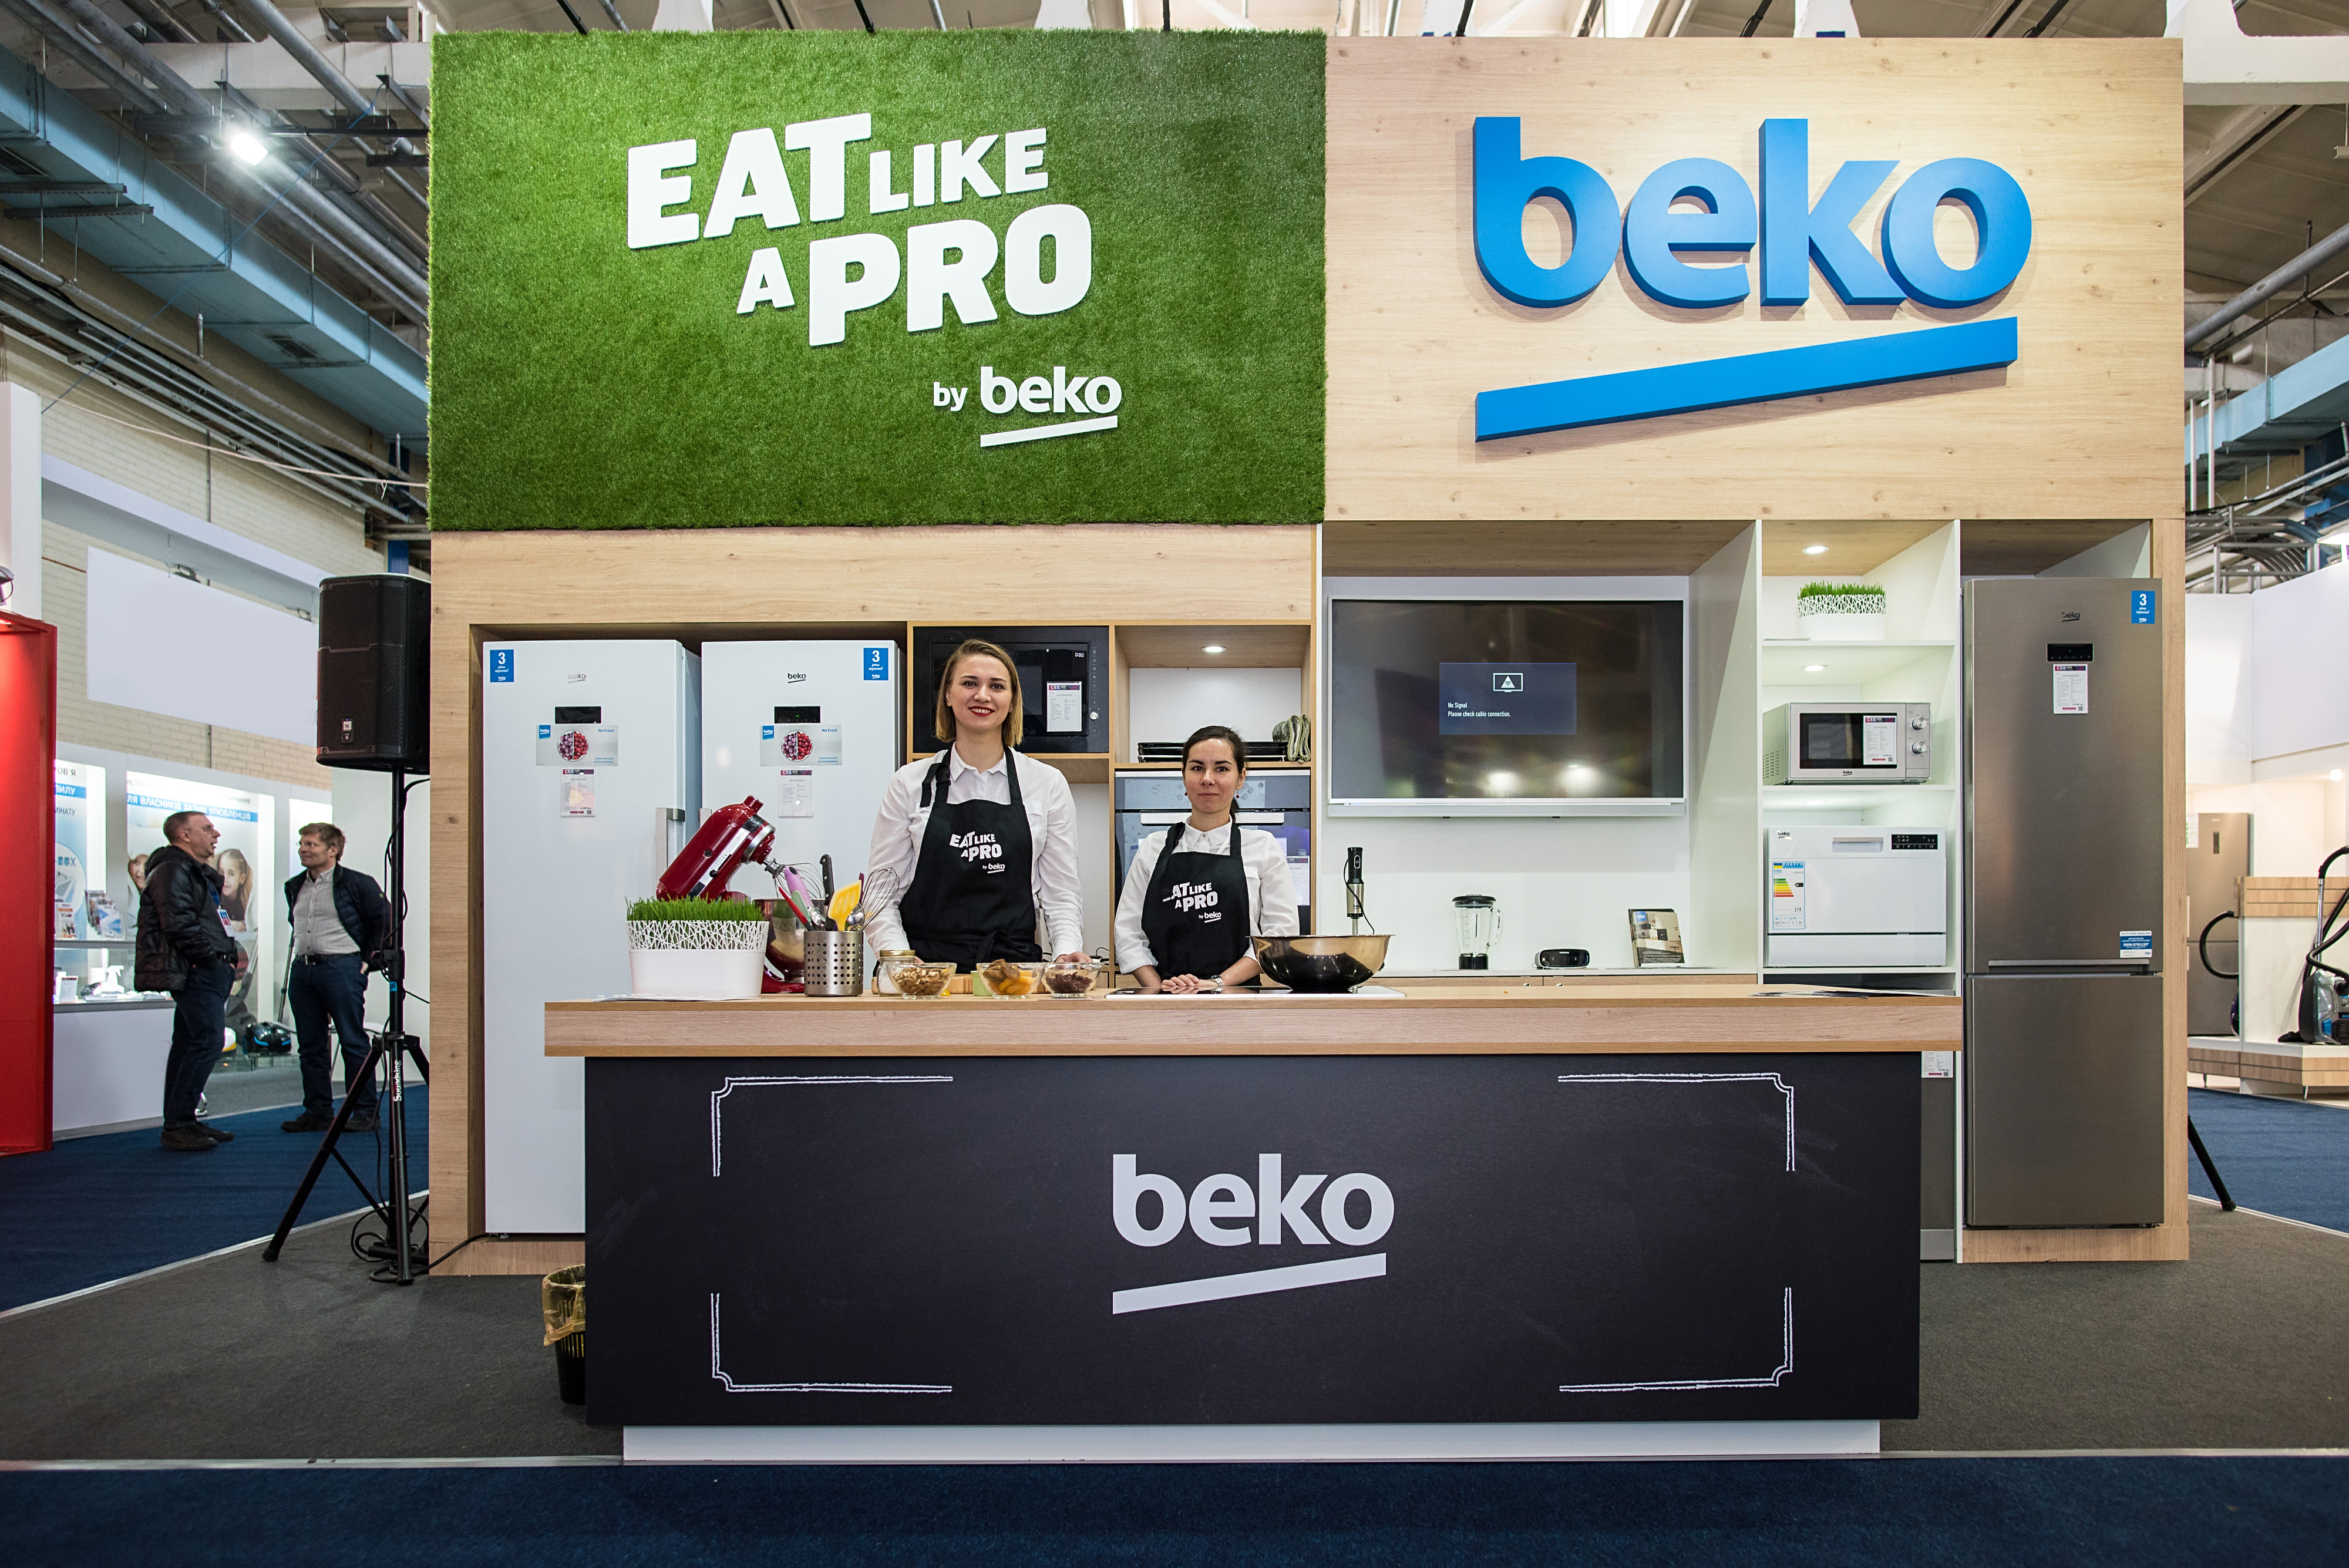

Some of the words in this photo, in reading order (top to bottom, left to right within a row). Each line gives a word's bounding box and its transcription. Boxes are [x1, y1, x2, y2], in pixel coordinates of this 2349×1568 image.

[628, 113, 871, 249] EAT
[869, 127, 1048, 214] LIKE
[1473, 116, 2032, 309] beko
[736, 247, 795, 314] A
[809, 203, 1092, 346] PRO
[933, 382, 968, 411] by
[980, 366, 1122, 413] beko
[2139, 593, 2147, 605] 3
[498, 652, 506, 664] 3
[872, 650, 880, 662] 3
[140, 796, 181, 810] ВЛАСНИКІВ
[210, 807, 251, 821] УЛЮБЛЕНЦІВ
[950, 831, 975, 848] EAT
[975, 834, 995, 844] LIKE
[968, 844, 1002, 862] PRO
[1163, 882, 1190, 901] AT
[1189, 883, 1212, 894] LIKE
[1174, 900, 1182, 909] A
[1183, 891, 1218, 912] PRO
[393, 1060, 402, 1102] Soundking
[1113, 1153, 1394, 1247] beko
